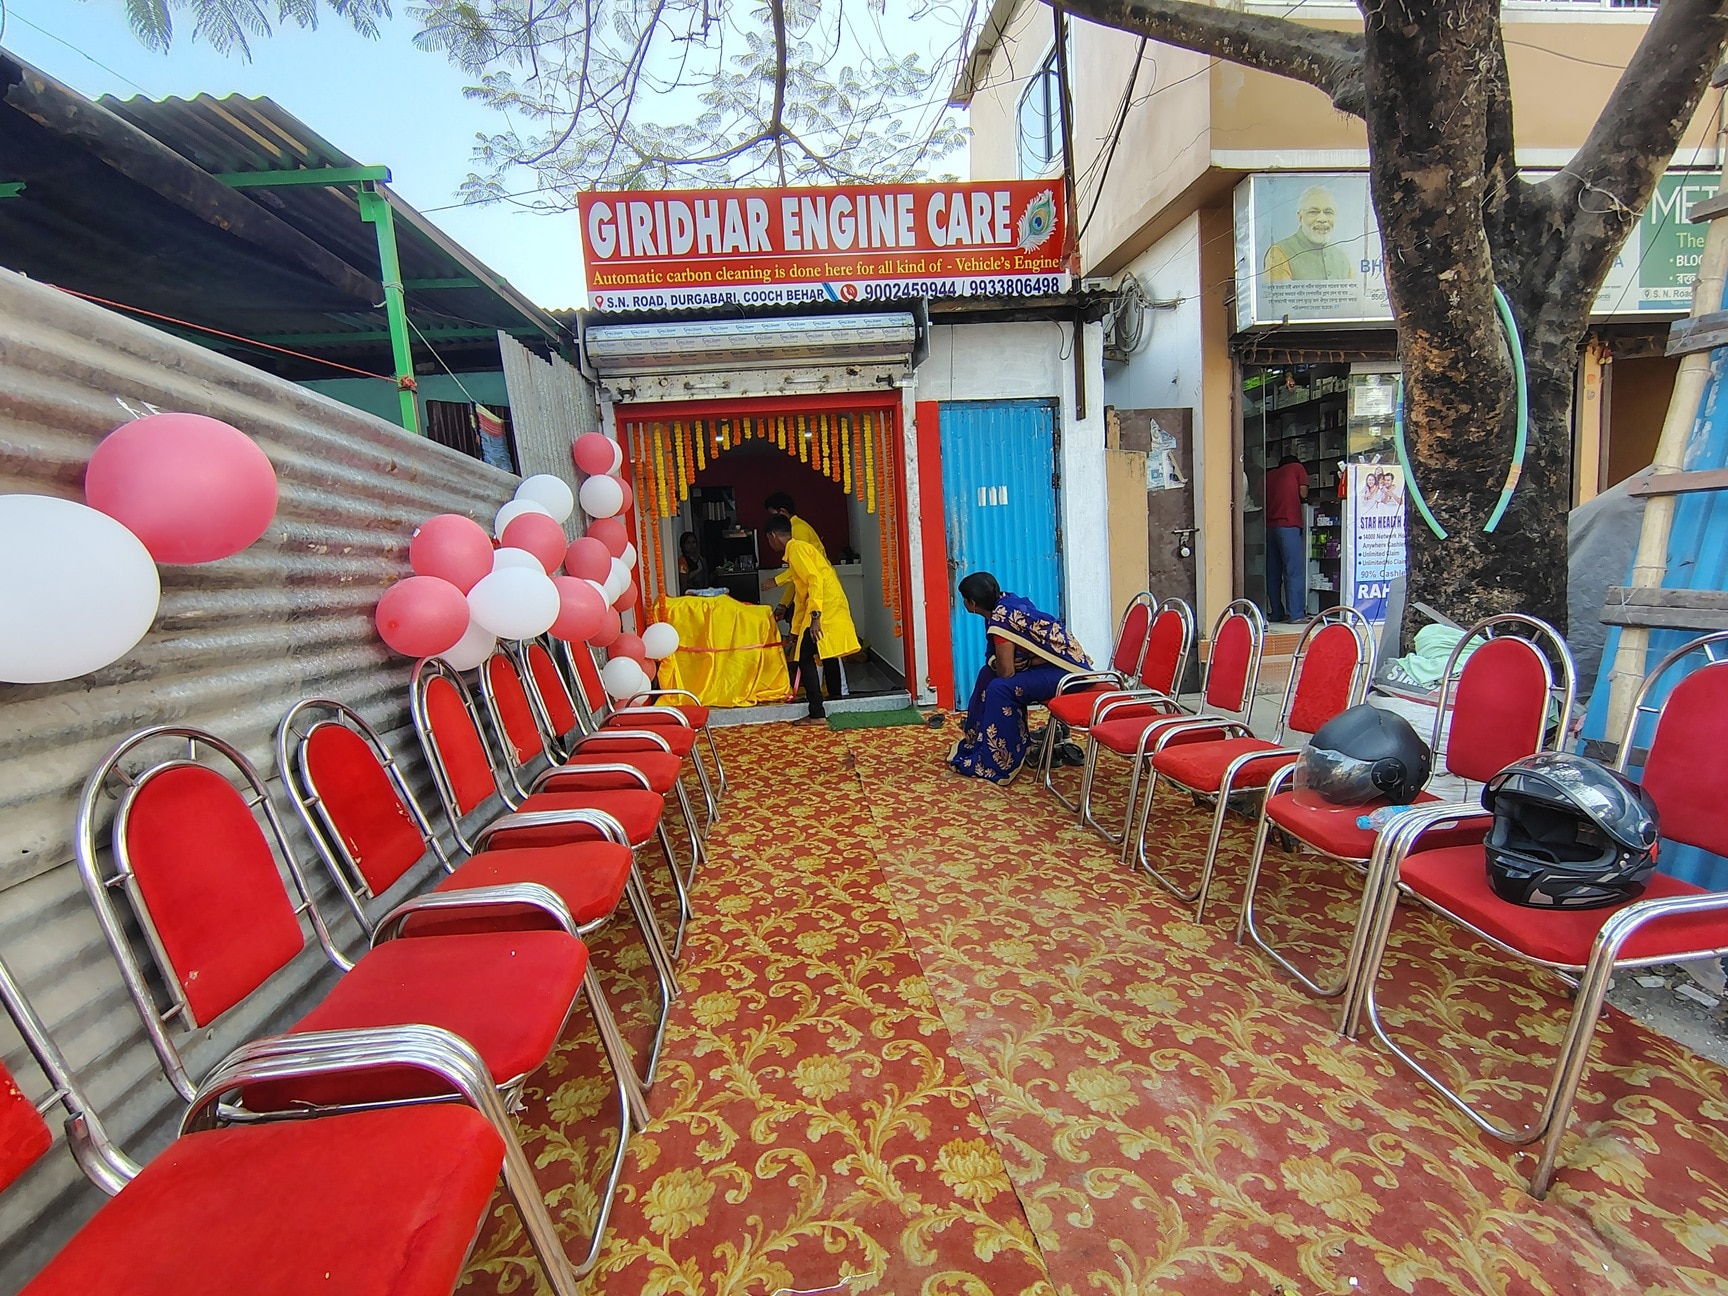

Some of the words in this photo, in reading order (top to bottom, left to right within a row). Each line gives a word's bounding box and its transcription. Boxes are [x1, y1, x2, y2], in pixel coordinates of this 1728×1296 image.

[588, 198, 773, 259] GIRIDHAR
[781, 193, 916, 251] ENGINE
[926, 191, 1012, 247] CARE
[1676, 232, 1705, 248] The
[592, 269, 663, 285] Automatic
[666, 267, 712, 282] carbon
[715, 265, 771, 283] cleaning
[774, 264, 786, 278] is
[789, 263, 822, 278] done
[825, 262, 853, 276] here
[856, 261, 875, 275] for
[878, 260, 893, 274] all
[896, 259, 925, 273] kind
[929, 258, 943, 273] of
[955, 256, 1011, 272] Vehicle's
[1014, 255, 1059, 273] Engine
[606, 297, 630, 308] S.N.
[633, 295, 667, 308] ROAD,
[743, 290, 783, 303] COOCH
[786, 288, 824, 301] BEHAR
[864, 281, 957, 300] 9002459944
[969, 277, 1059, 296] 9933806498
[1360, 516, 1377, 529] STAR
[1377, 515, 1402, 529] HEALTH
[1360, 571, 1377, 579] 90%
